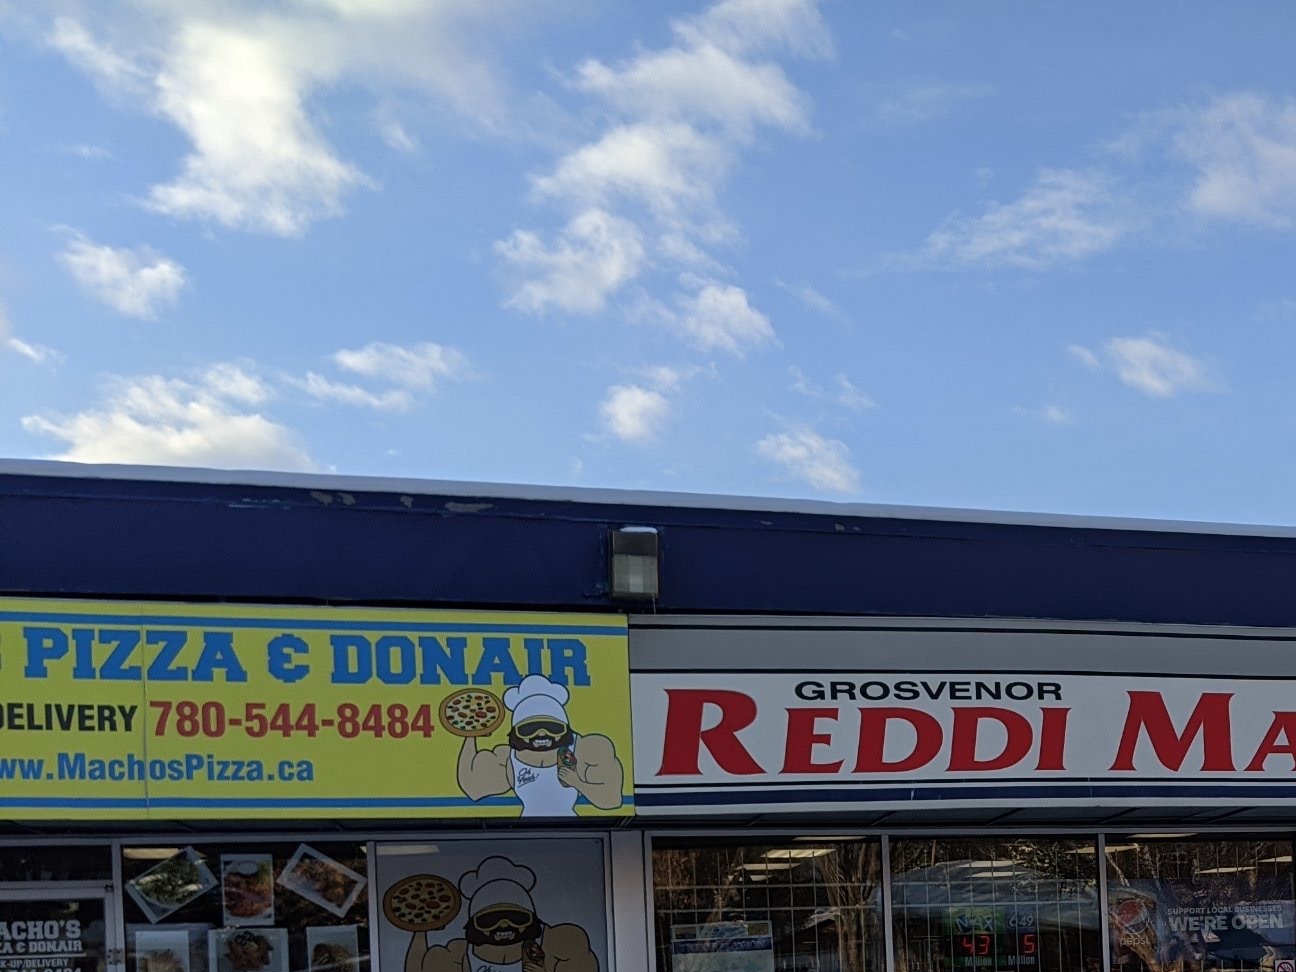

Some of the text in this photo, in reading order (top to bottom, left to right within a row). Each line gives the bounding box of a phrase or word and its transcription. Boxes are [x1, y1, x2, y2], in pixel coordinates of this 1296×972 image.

[24, 626, 592, 686] PIZZA & DONAIR
[794, 681, 1063, 701] GROSVENOR
[0, 701, 435, 739] ELIVERY 780-544-8484
[655, 688, 1073, 777] REDDI
[1168, 905, 1282, 915] SUPPORT LOCAL BUSINESSES
[1168, 914, 1284, 932] WE'RE OPEN
[28, 940, 83, 953] DONAIR
